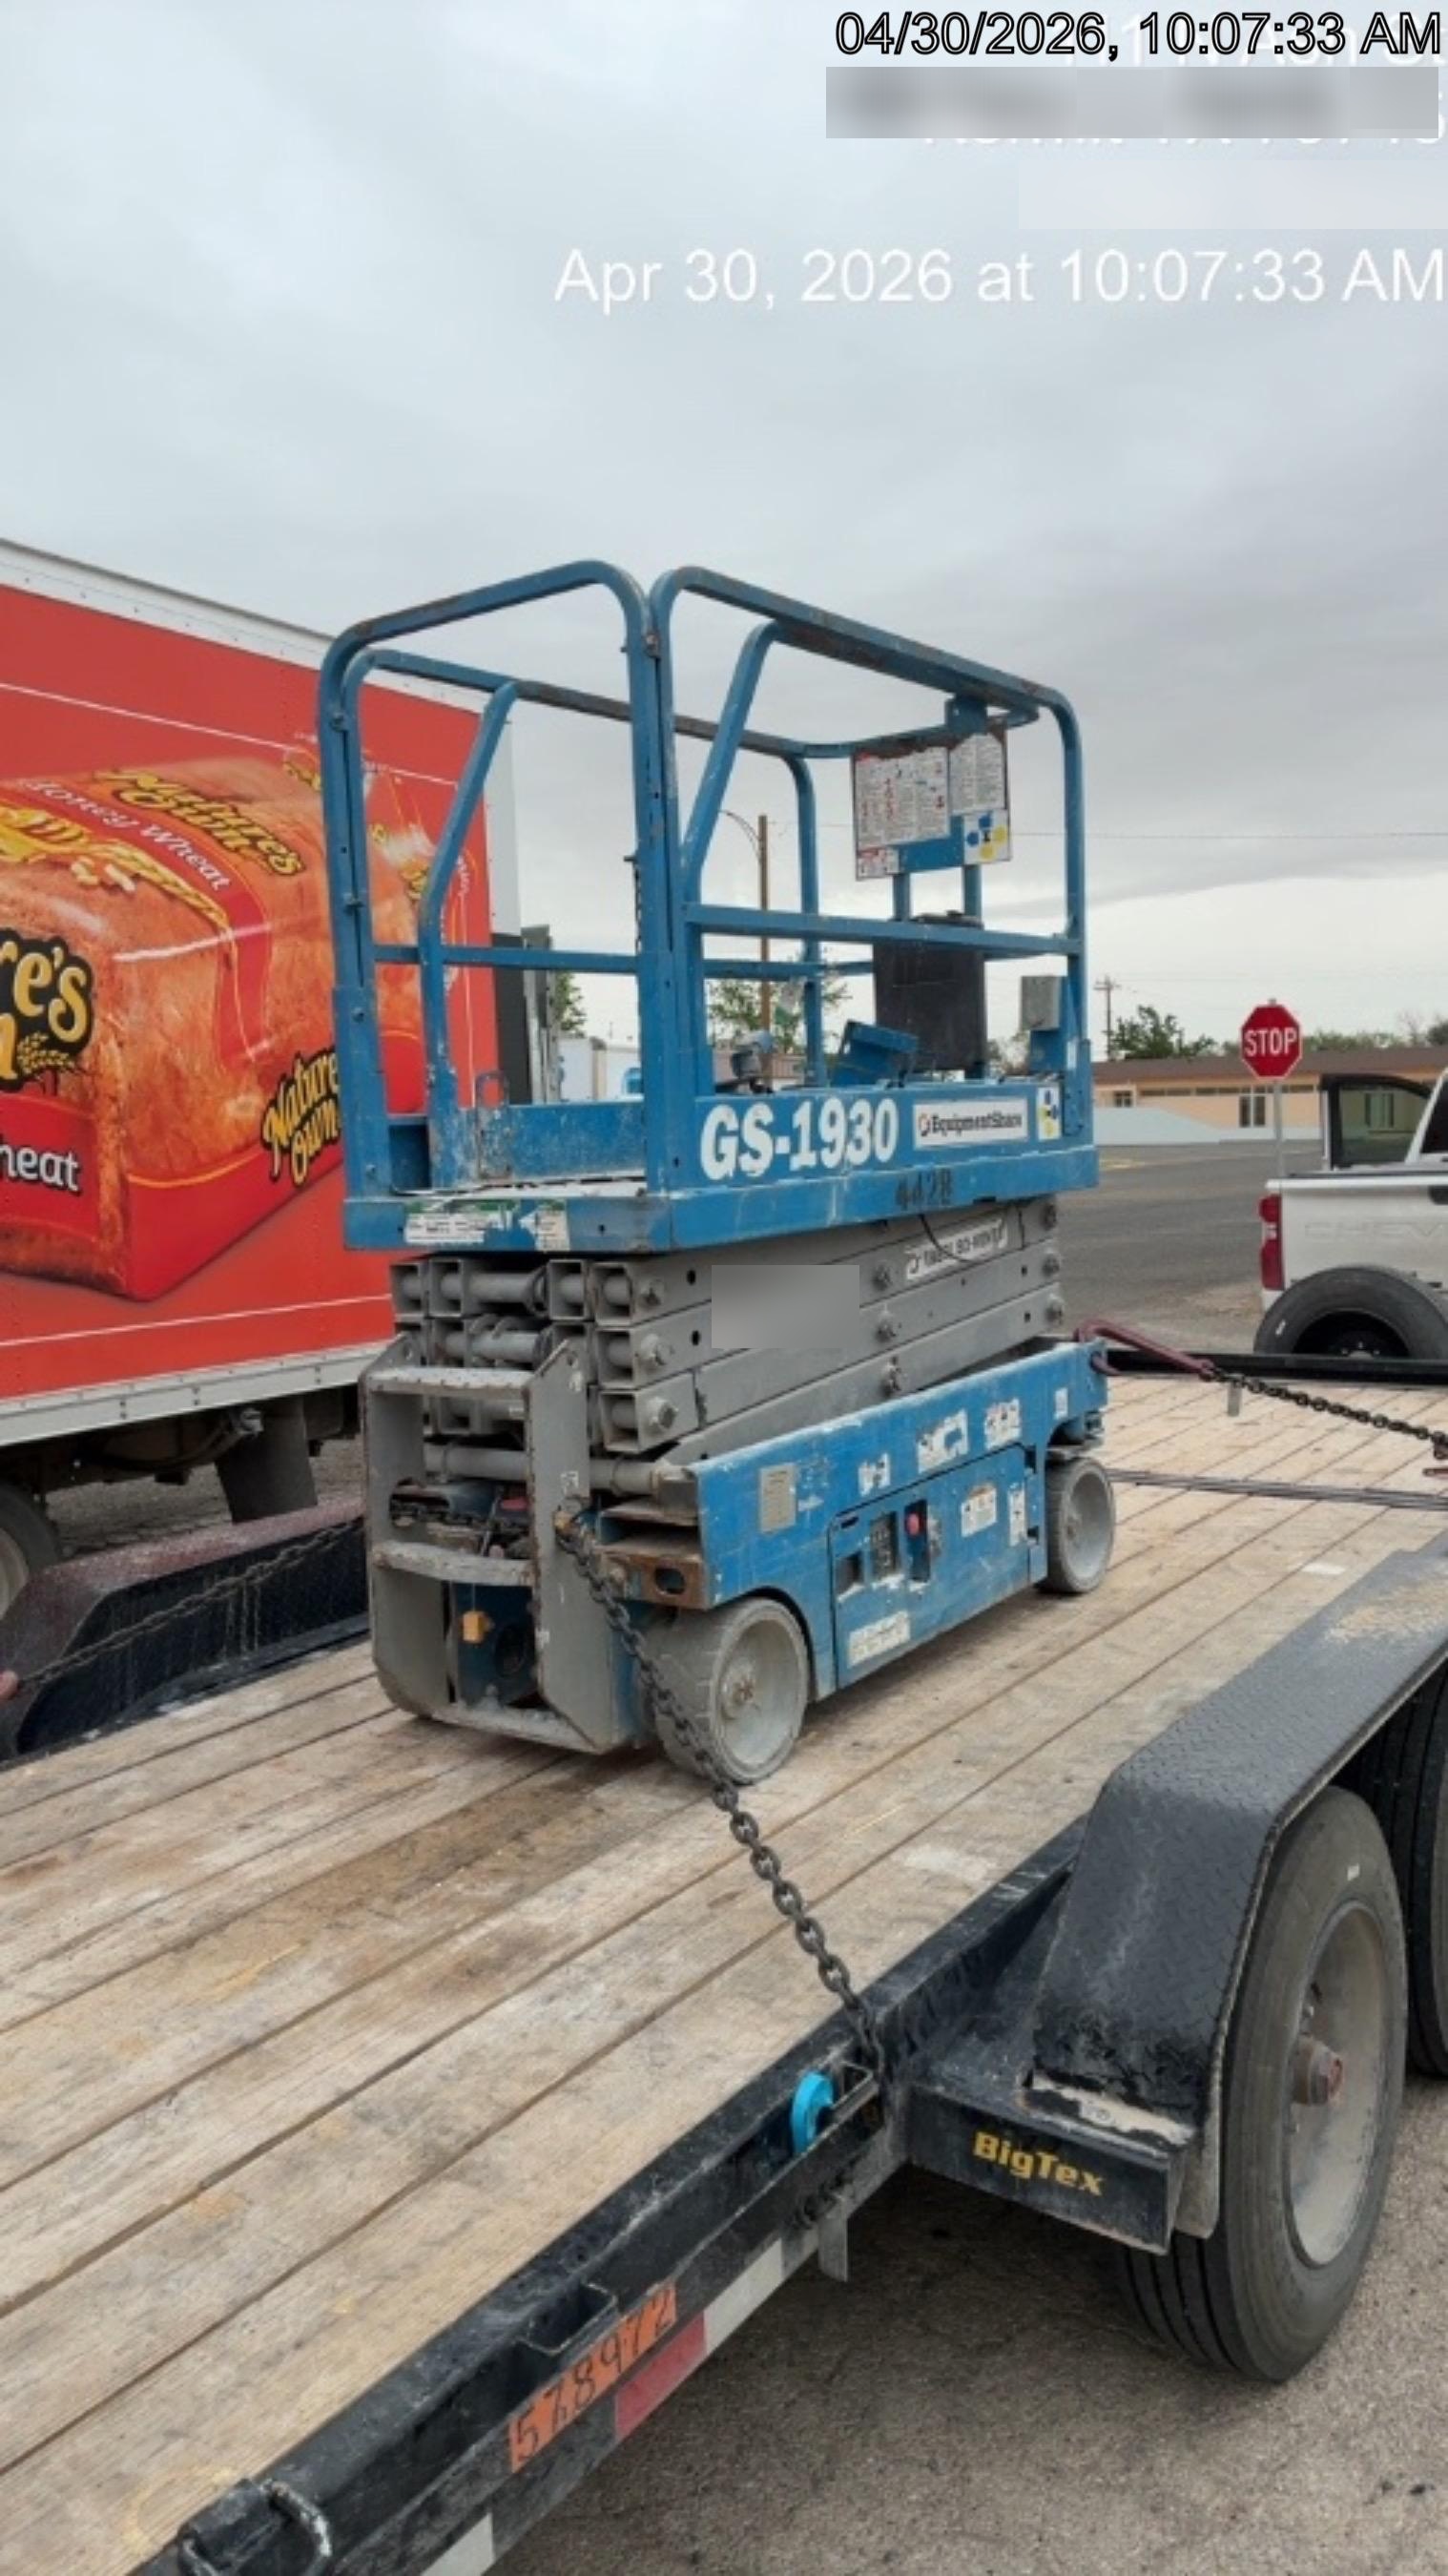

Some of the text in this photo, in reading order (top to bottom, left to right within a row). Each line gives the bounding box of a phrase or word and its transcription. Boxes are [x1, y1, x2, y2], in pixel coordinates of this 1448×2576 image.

[139, 822, 232, 891] Wheat
[1243, 1026, 1298, 1058] STOP
[262, 1053, 341, 1178] Nature
[700, 1097, 899, 1181] GS-1930
[932, 1111, 1023, 1137] EquipmentShare
[973, 2130, 1104, 2196] BigTex
